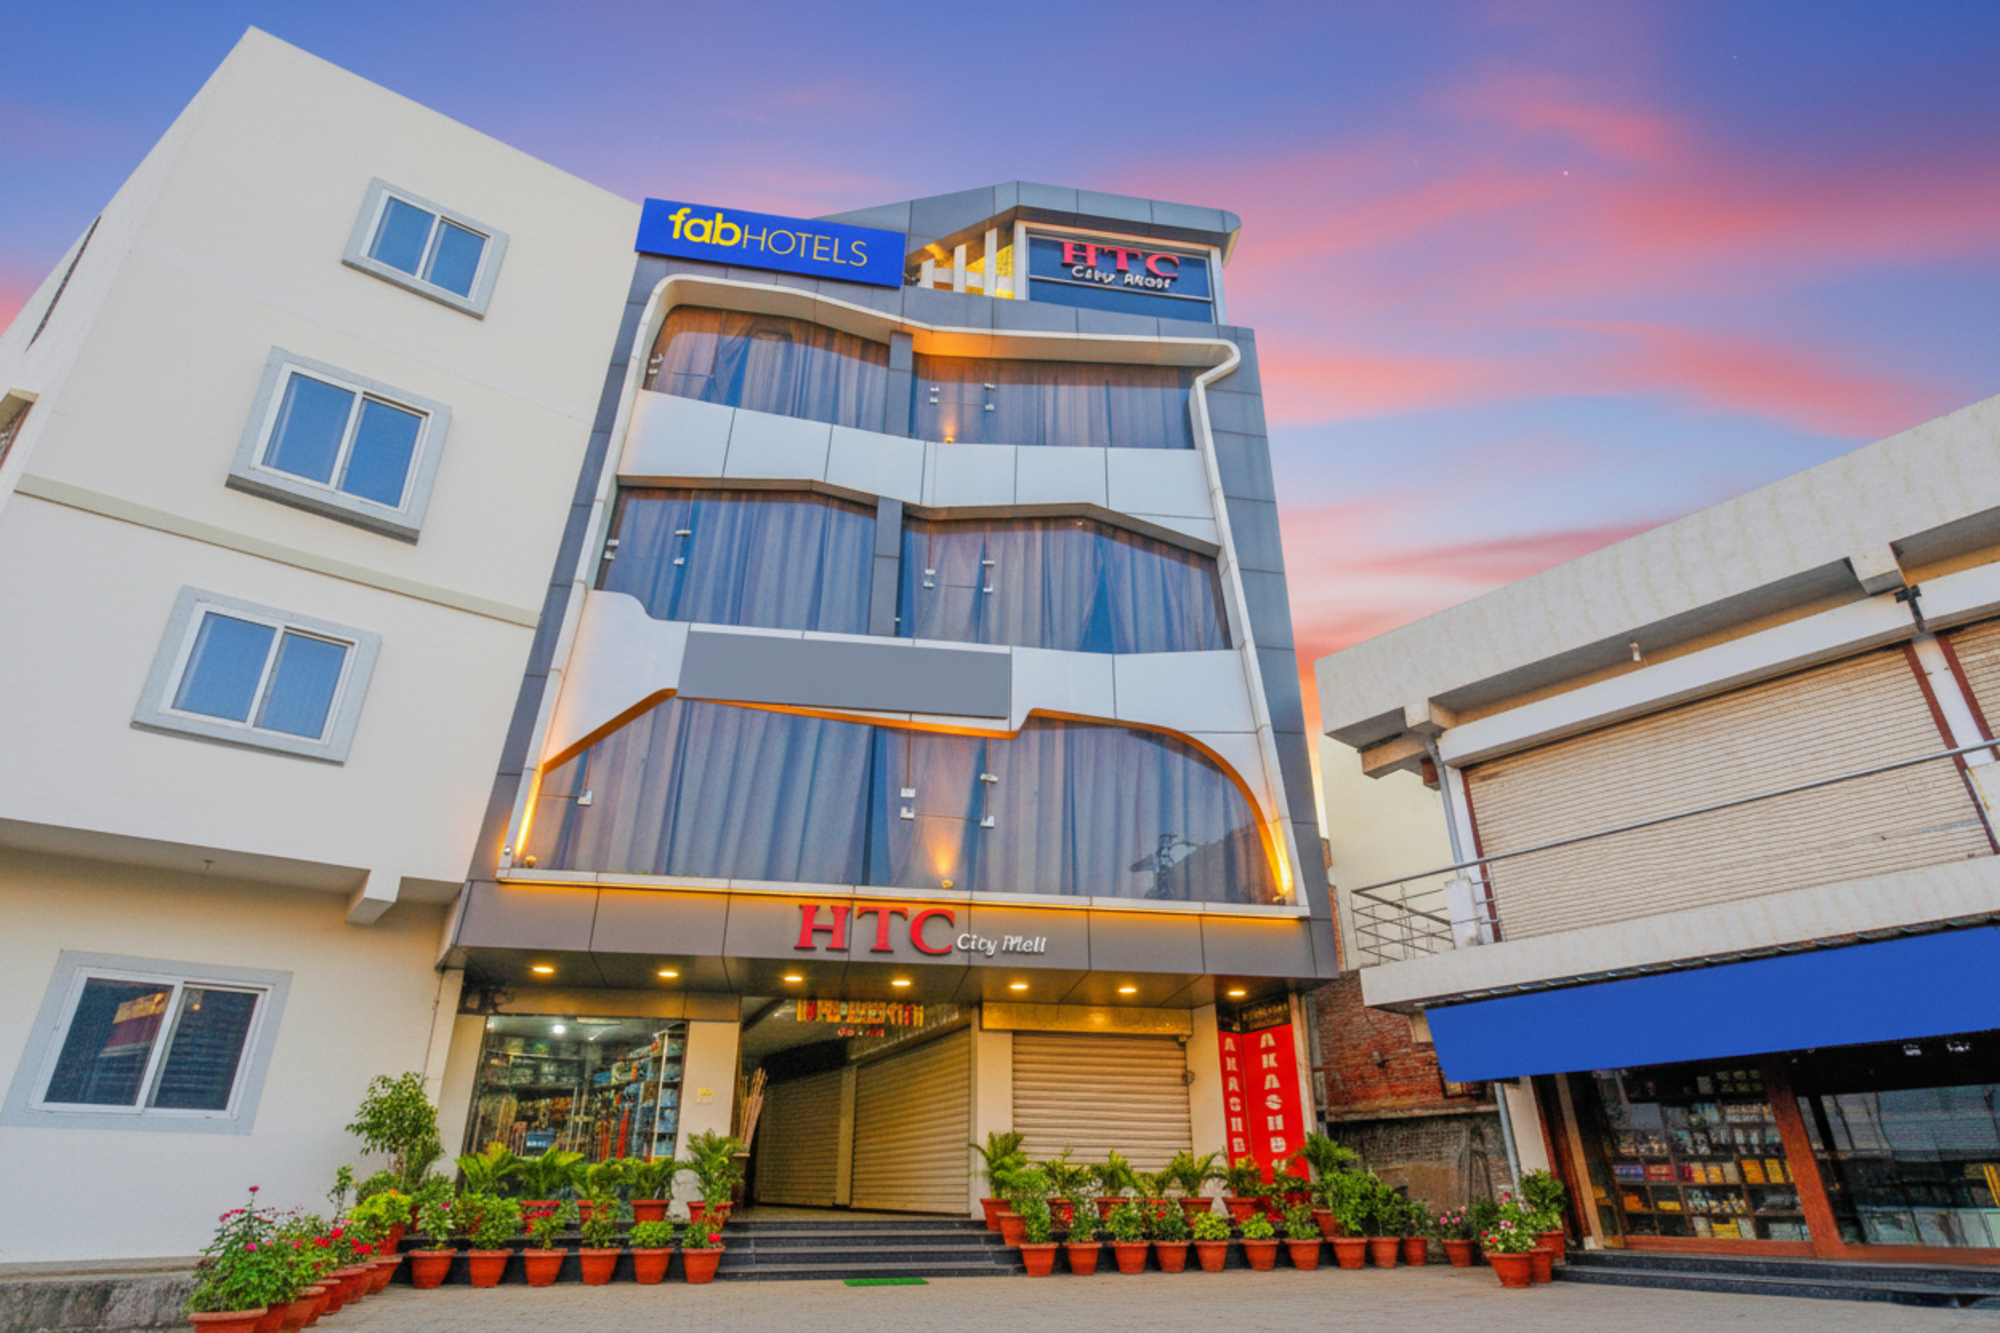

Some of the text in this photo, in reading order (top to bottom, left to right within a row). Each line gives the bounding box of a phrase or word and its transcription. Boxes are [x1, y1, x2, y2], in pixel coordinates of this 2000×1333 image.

[1062, 241, 1180, 278] HTC
[794, 904, 955, 956] HTC
[957, 933, 998, 957] City
